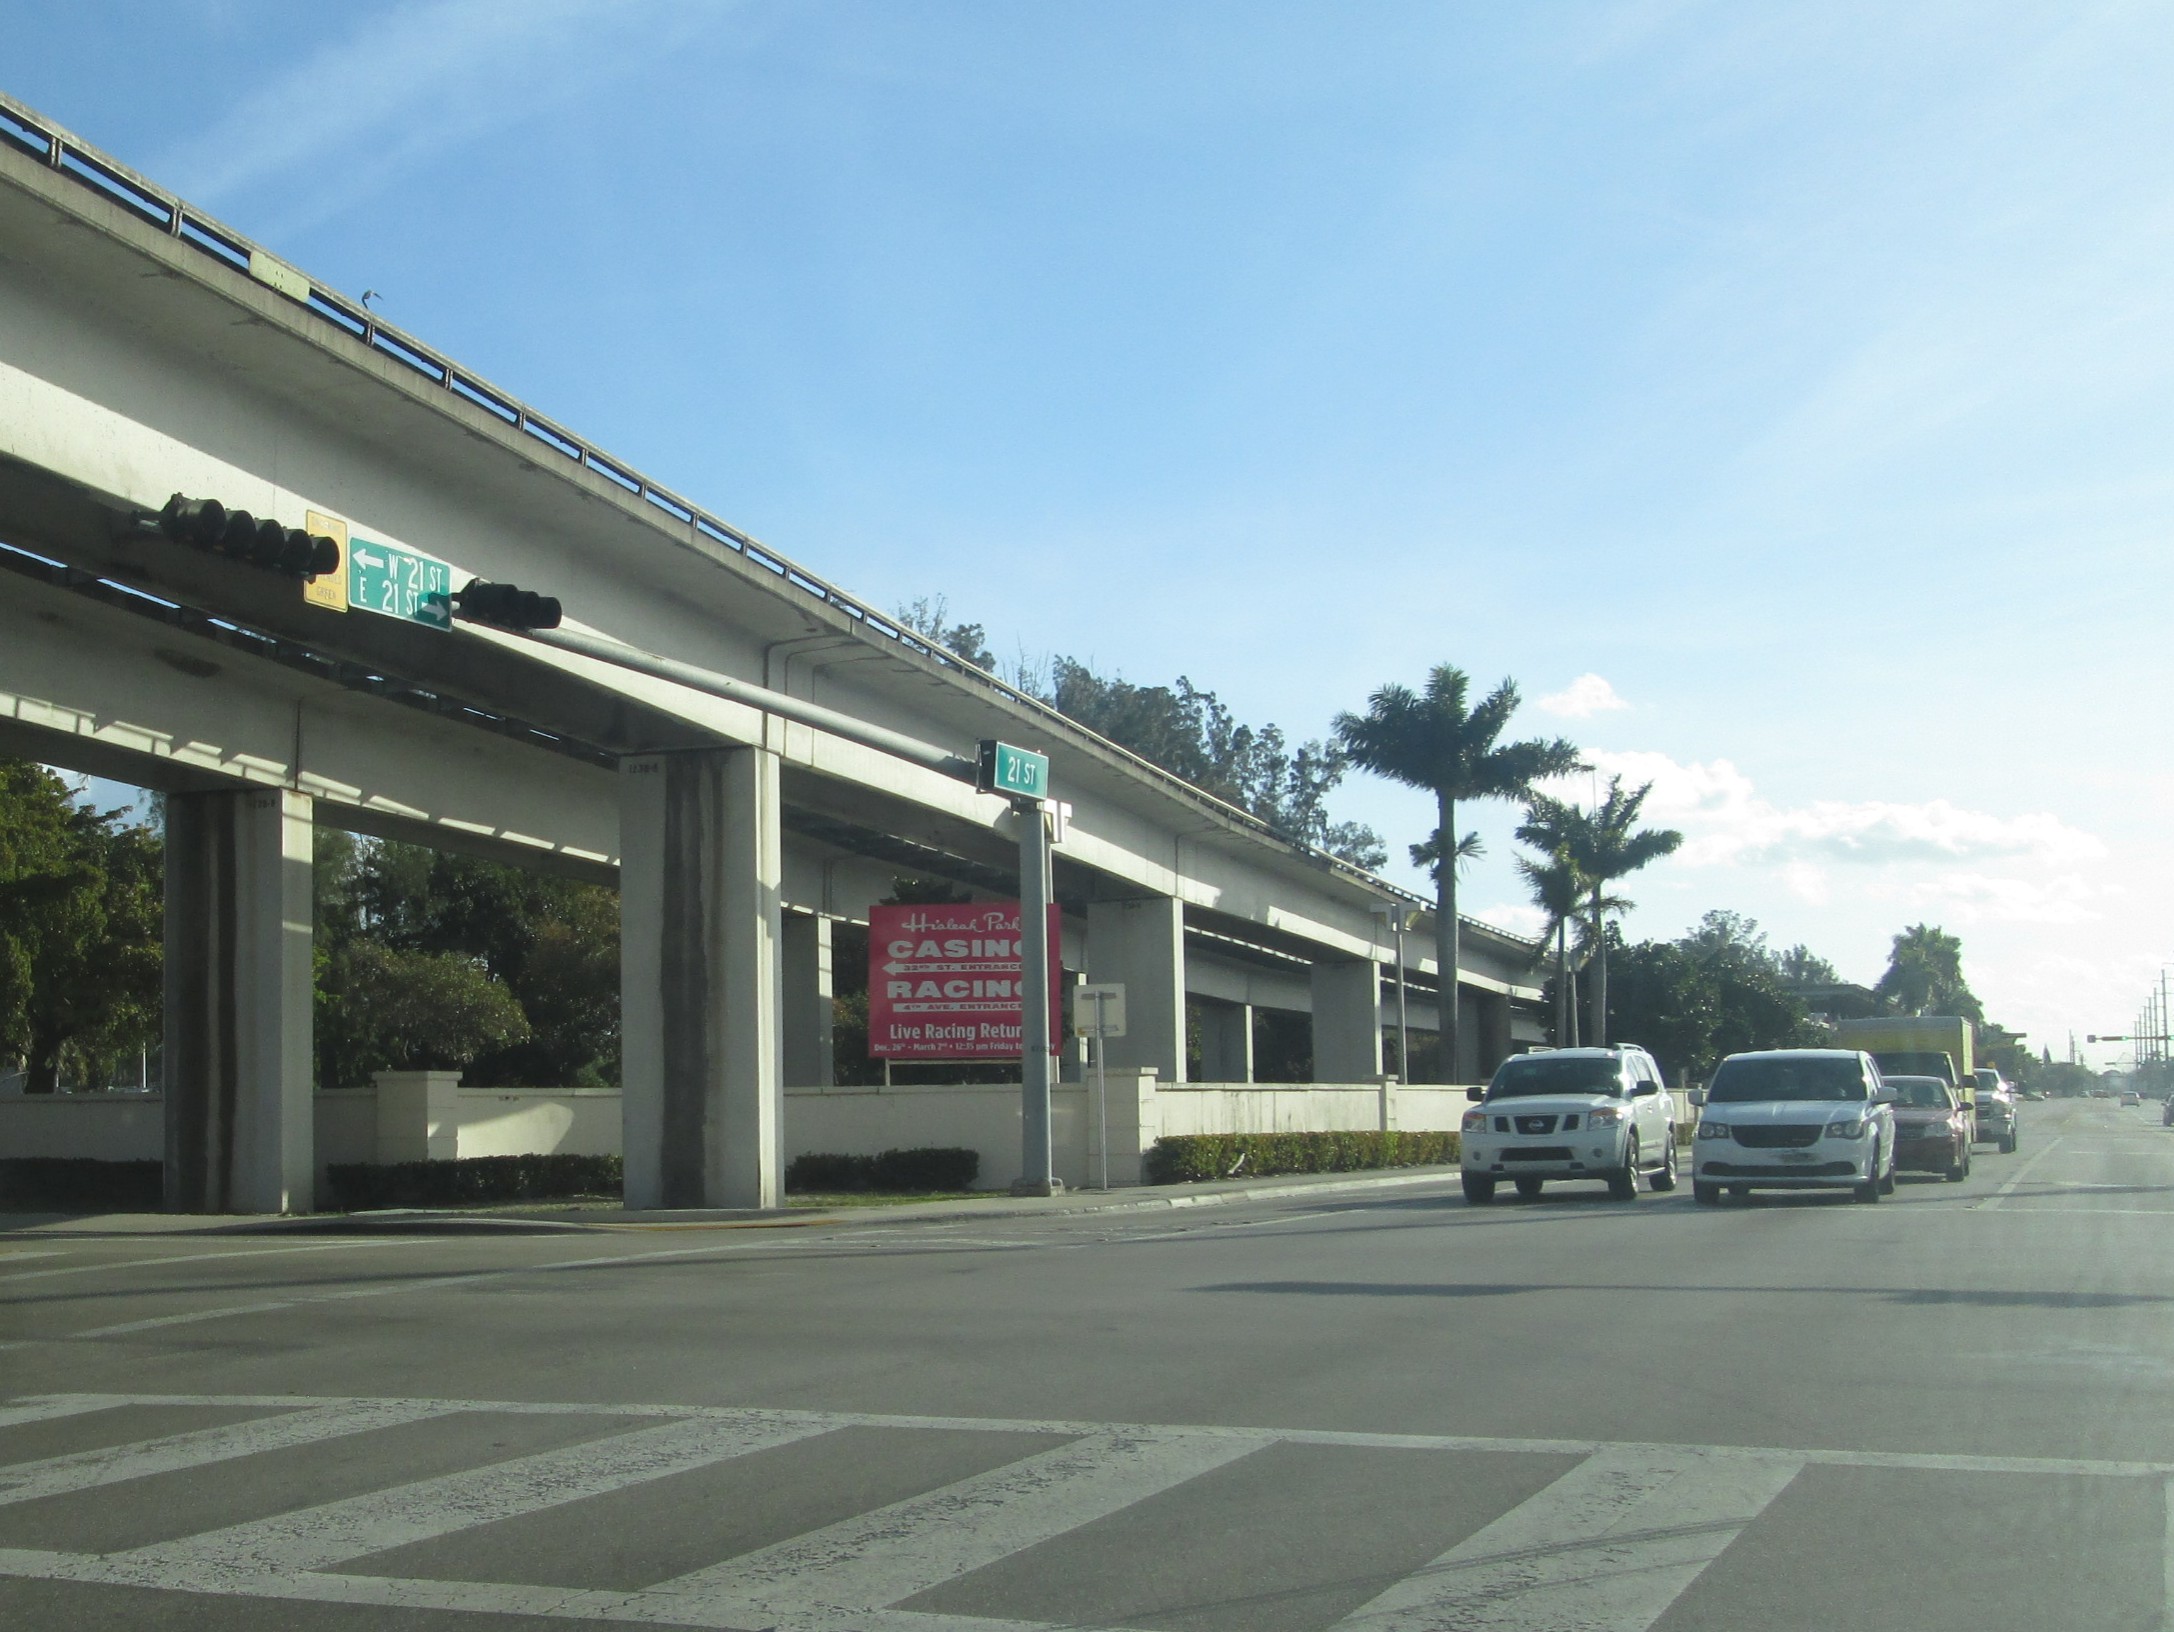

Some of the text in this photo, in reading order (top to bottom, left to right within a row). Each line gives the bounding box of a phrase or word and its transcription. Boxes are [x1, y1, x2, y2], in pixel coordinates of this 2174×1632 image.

[388, 553, 443, 593] W 21 ST
[359, 576, 368, 603] E
[382, 580, 399, 614] 21
[406, 589, 419, 616] ST
[1007, 756, 1036, 785] 21 ST
[901, 912, 1022, 933] Hialeah Park
[960, 963, 1022, 971] ENTRANC
[959, 1003, 1022, 1011] ENTRANC
[890, 1022, 1022, 1041] Live Racing Retur
[913, 1043, 936, 1051] March
[976, 1044, 988, 1052] pm
[990, 1043, 1014, 1052] Friday
